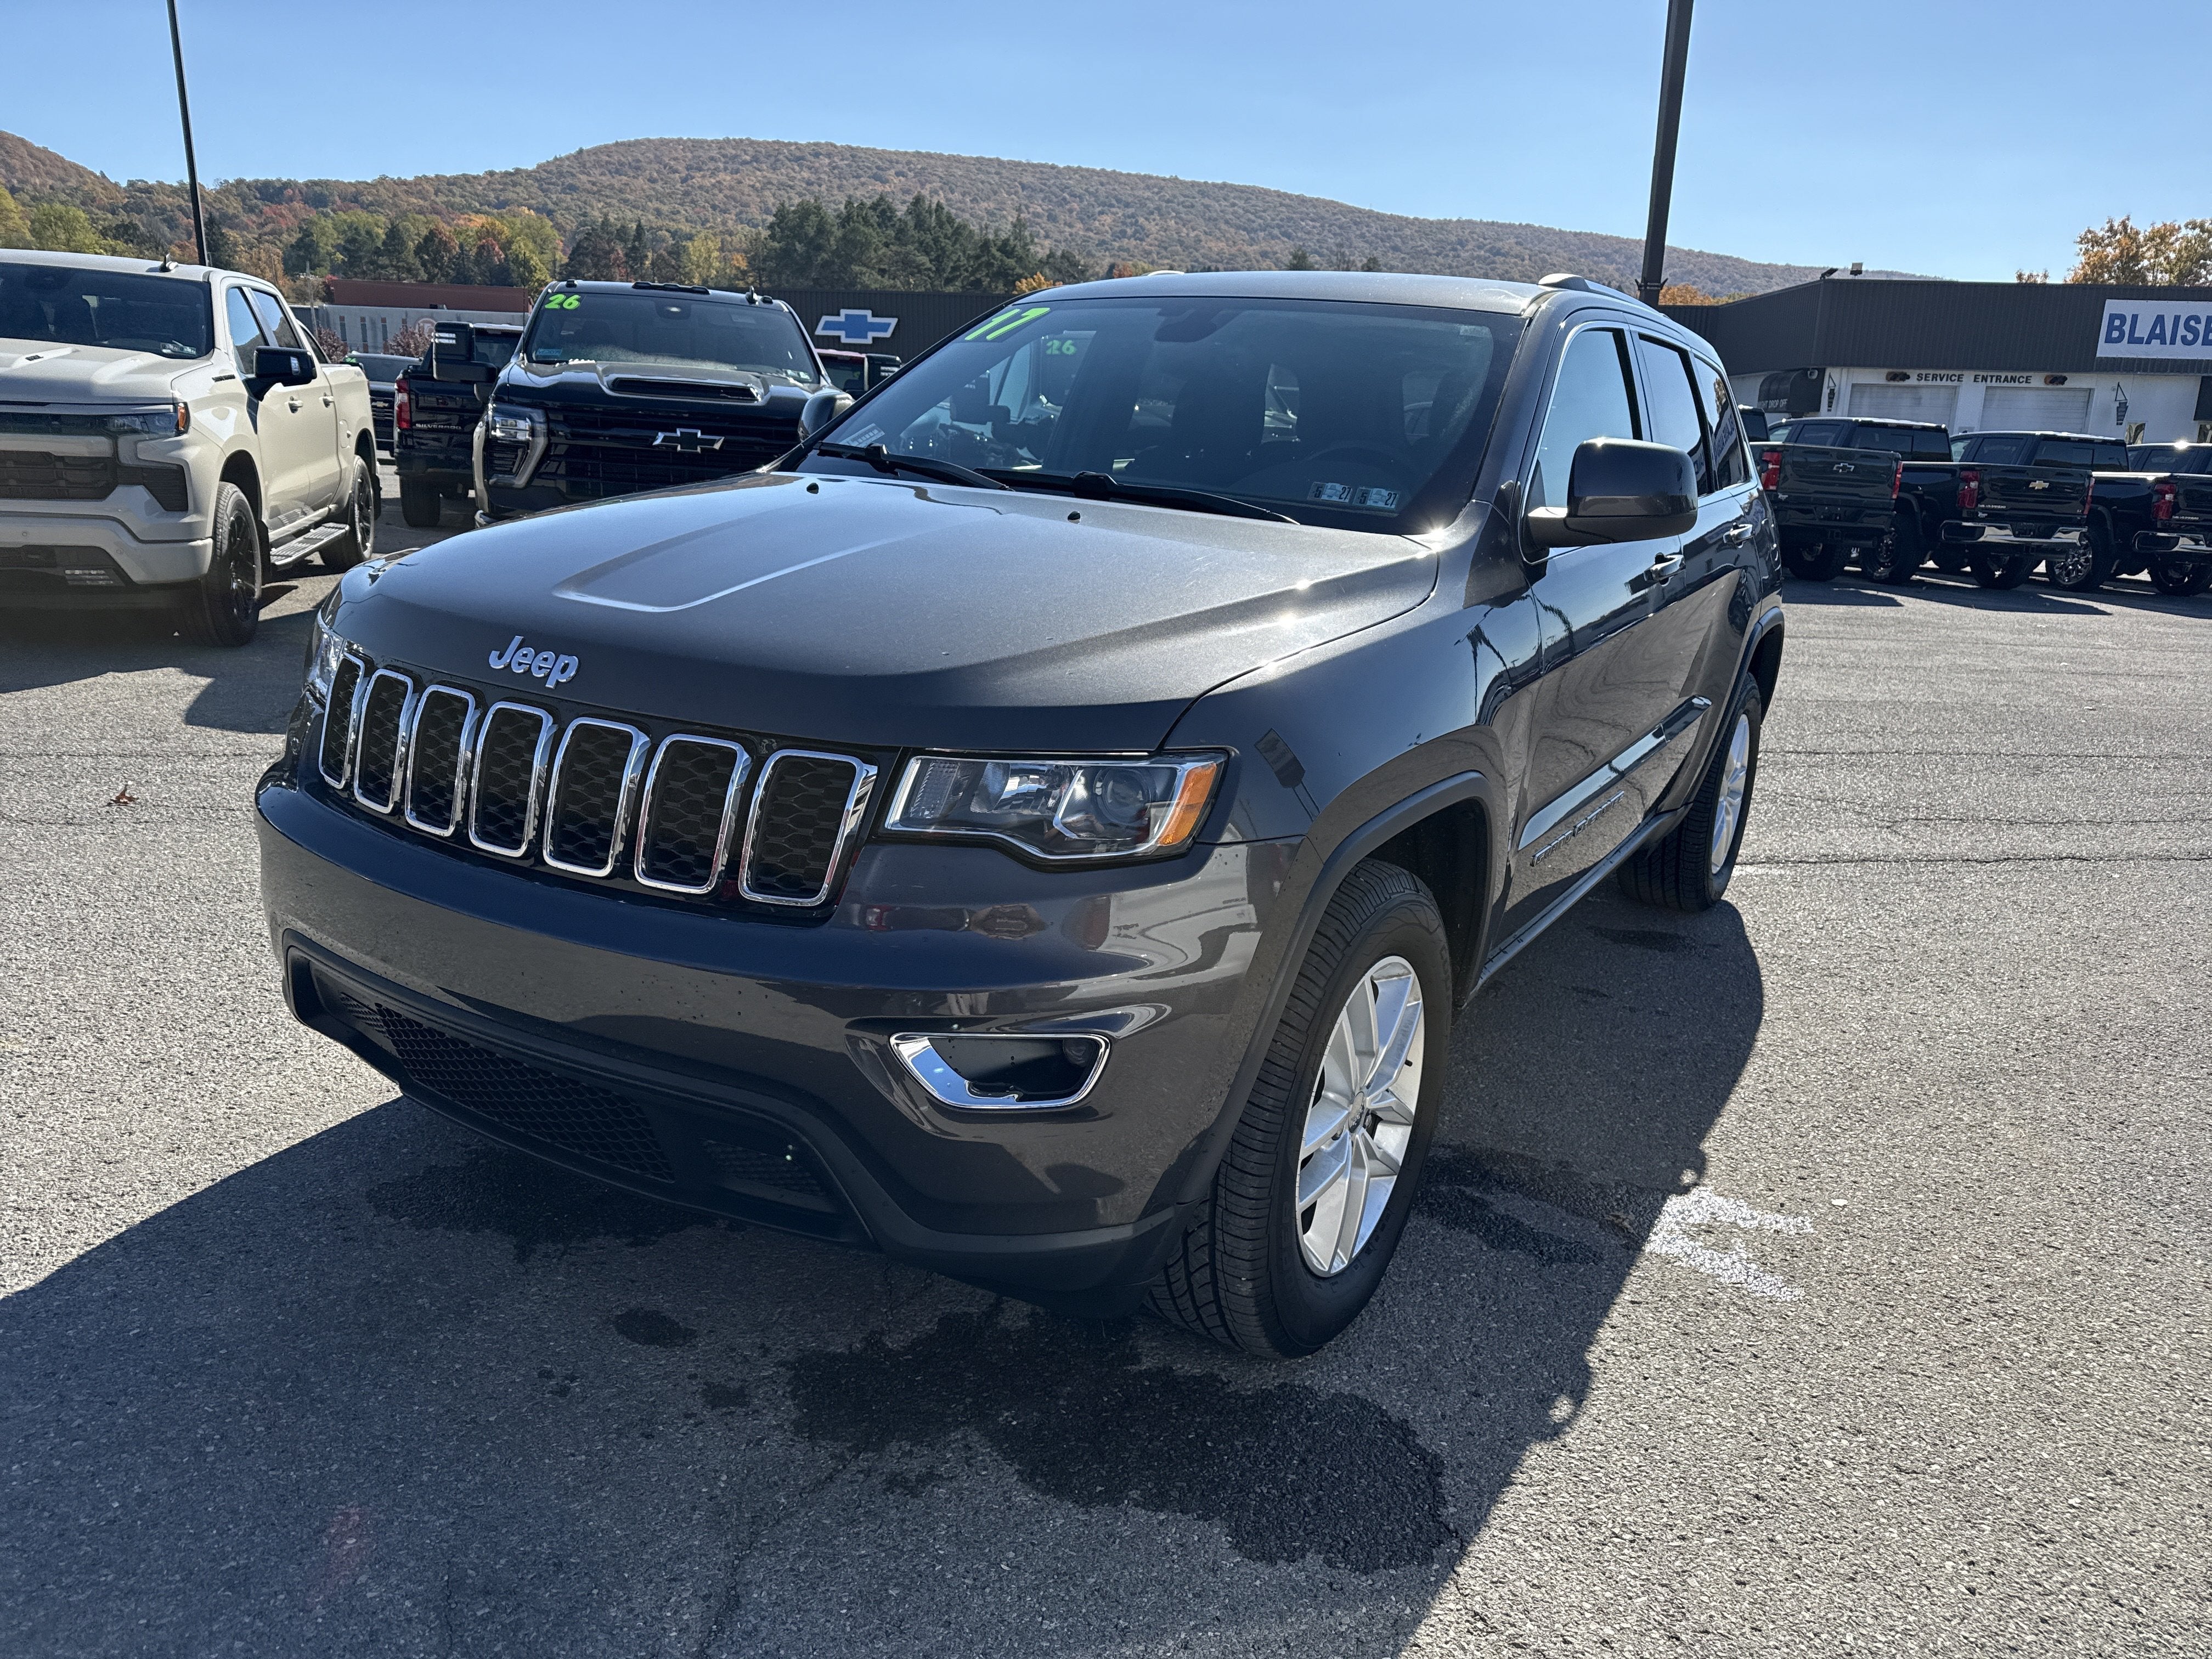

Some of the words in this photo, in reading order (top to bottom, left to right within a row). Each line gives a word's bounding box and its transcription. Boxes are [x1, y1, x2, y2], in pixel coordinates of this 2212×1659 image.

[544, 294, 581, 310] 26
[964, 307, 1051, 341] 17
[1046, 339, 1077, 356] 26
[1916, 373, 1964, 382] SERVICE
[1973, 374, 2033, 384] ENTRANCE
[1768, 399, 1779, 409] DROP
[1779, 398, 1788, 408] OFF
[1314, 486, 1323, 498] 5
[1338, 486, 1352, 500] 27
[1359, 492, 1368, 504] 5
[1384, 492, 1398, 506] 27
[488, 635, 580, 690] Jeep
